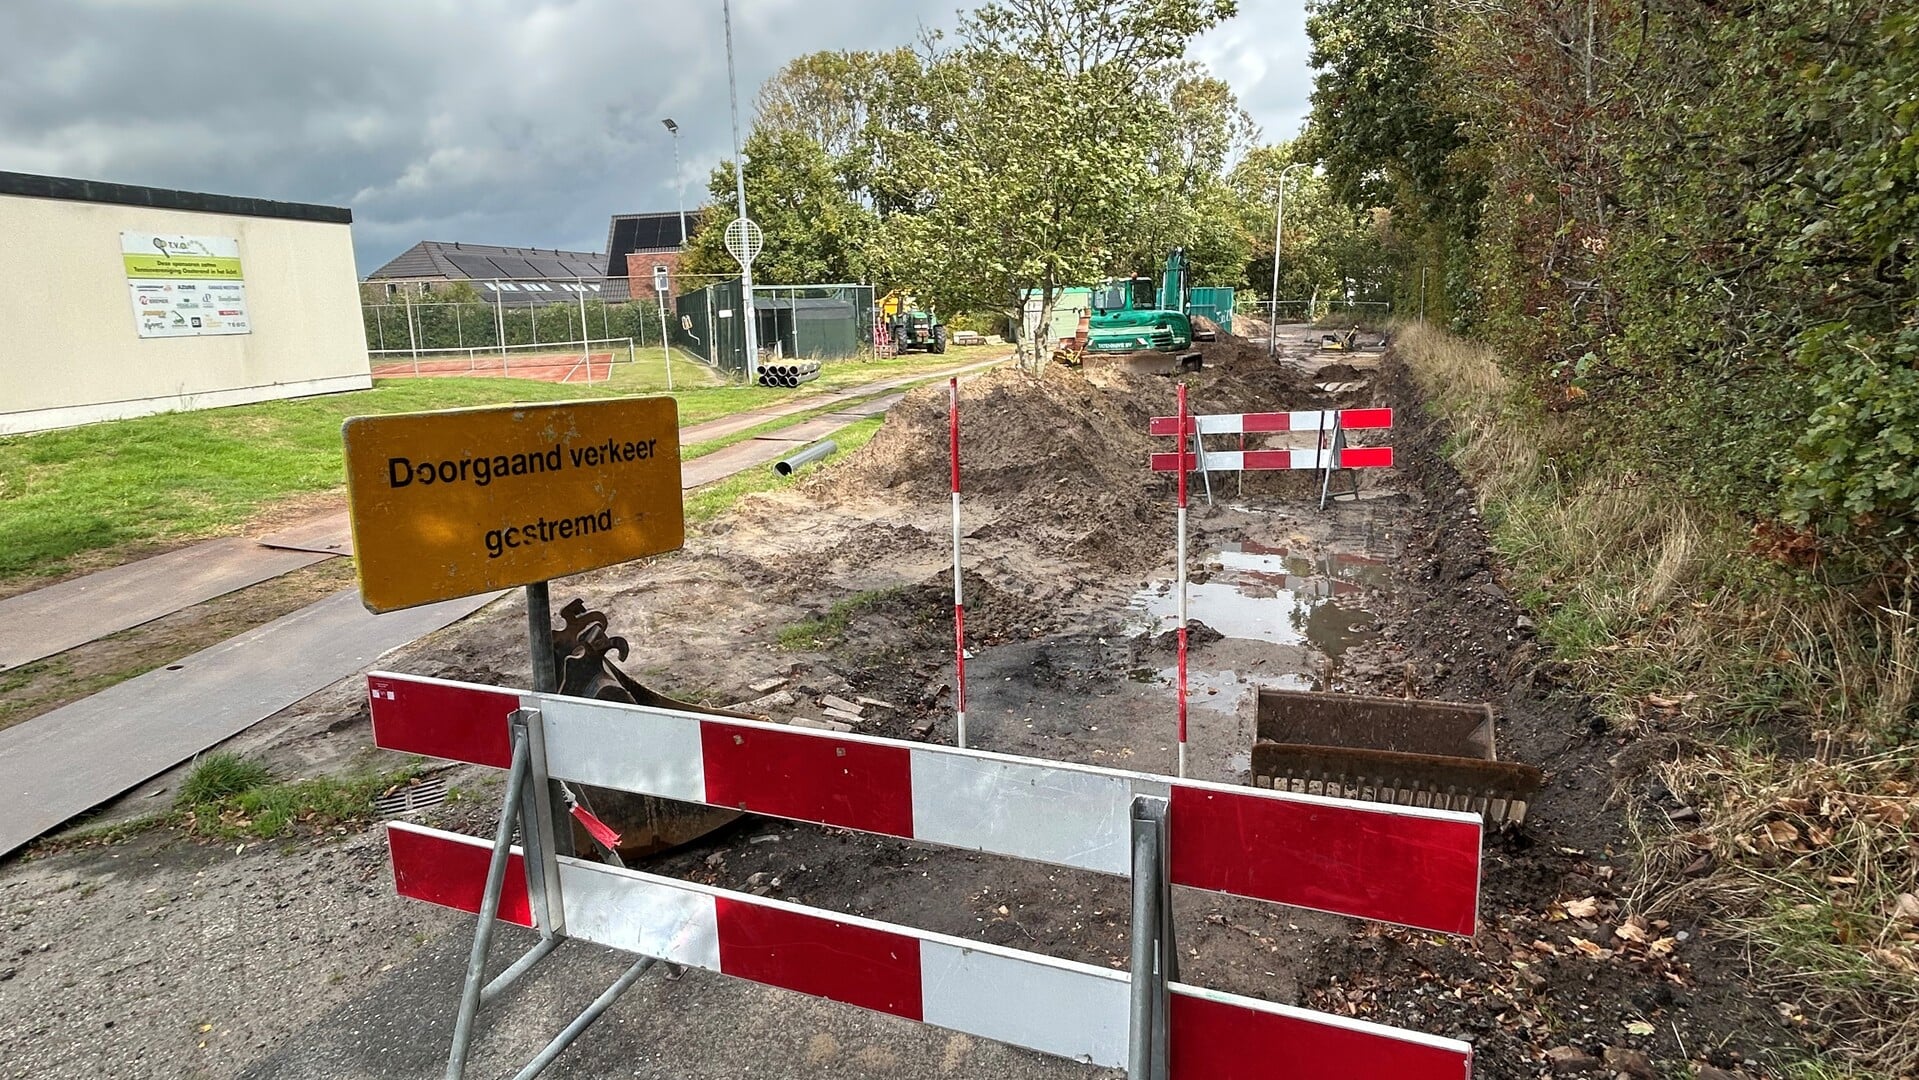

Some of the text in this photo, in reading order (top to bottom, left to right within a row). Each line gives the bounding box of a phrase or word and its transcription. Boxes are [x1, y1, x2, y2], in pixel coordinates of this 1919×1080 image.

[388, 438, 657, 489] Doorgaand verkeer
[485, 509, 612, 559] gestremd
